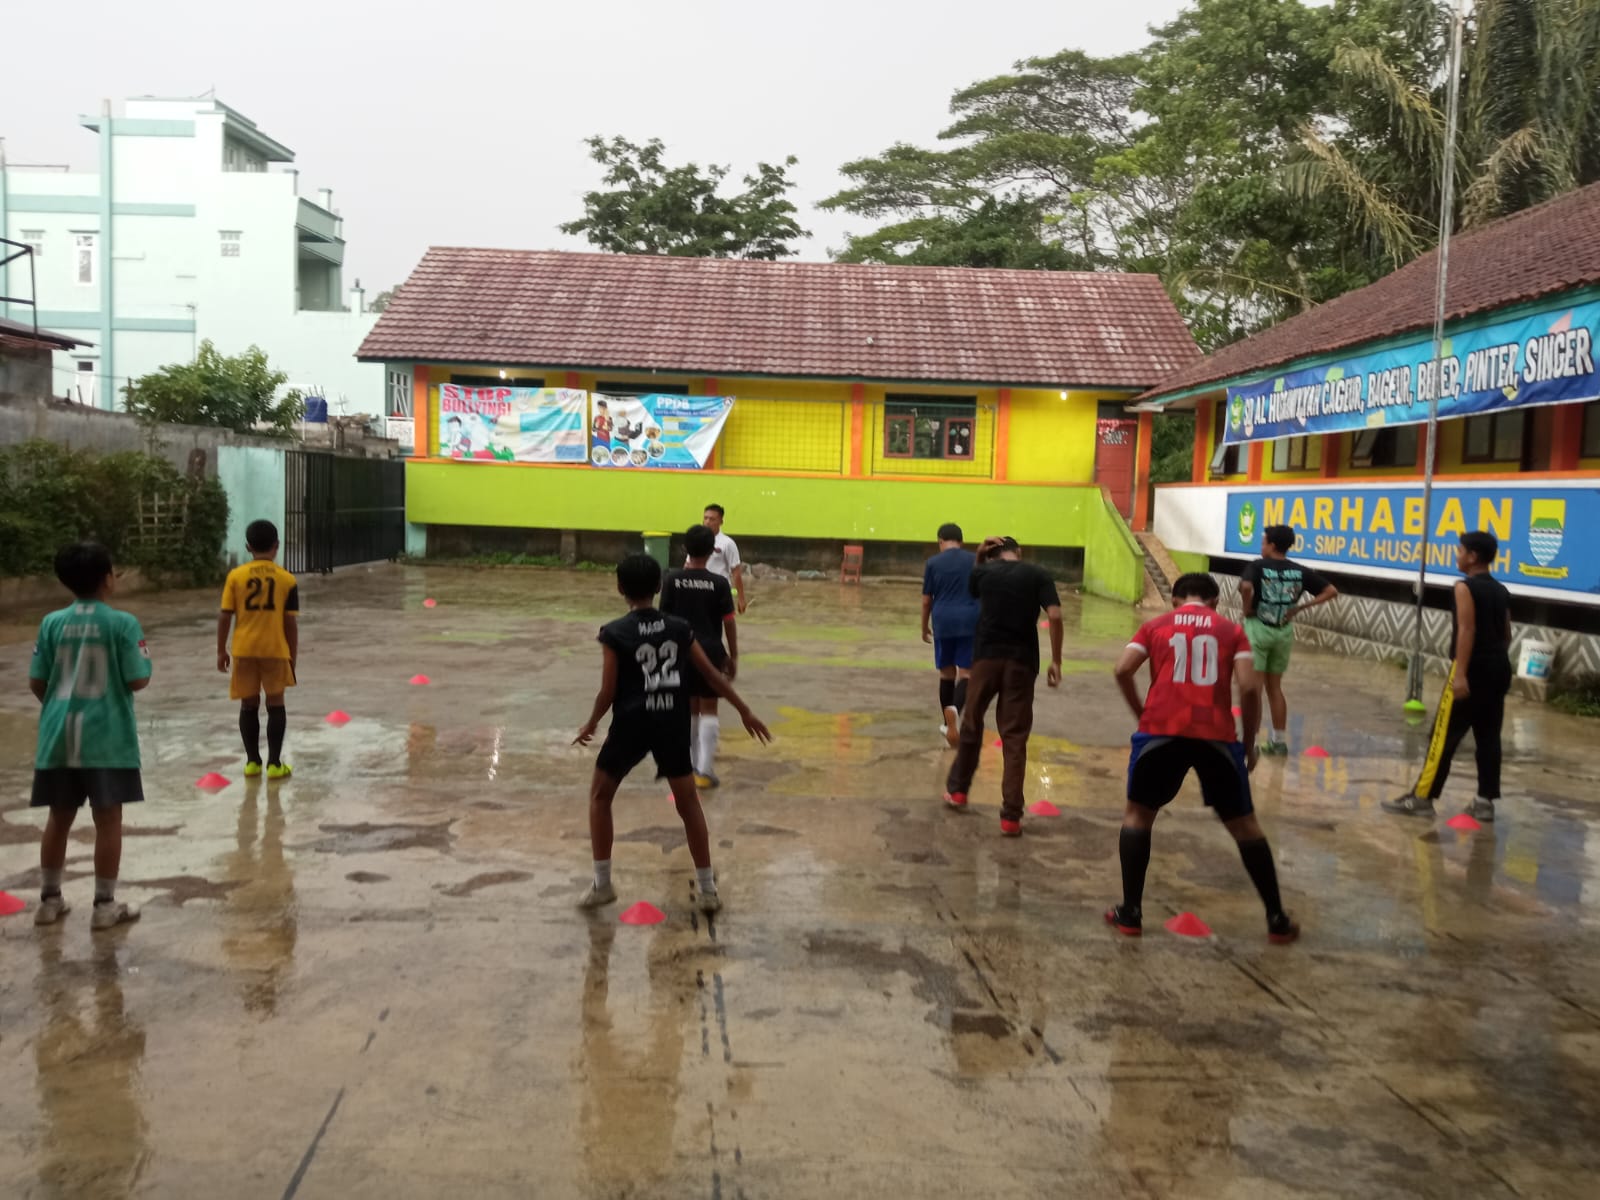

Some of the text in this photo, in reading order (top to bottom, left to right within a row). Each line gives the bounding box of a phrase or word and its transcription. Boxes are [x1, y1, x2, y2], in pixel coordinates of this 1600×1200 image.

[443, 386, 512, 400] STOP
[1322, 376, 1365, 414] CAGEUR,
[1367, 366, 1414, 407] BAGEUR,
[1463, 343, 1520, 394] PINTER,
[1523, 327, 1594, 384] SINGER
[442, 398, 512, 416] BULLYING!
[1263, 496, 1513, 541] MARHABAN
[1314, 535, 1347, 556] SMP
[1348, 537, 1370, 559] AL
[245, 576, 276, 611] 21
[54, 643, 109, 700] 10
[635, 639, 681, 692] 22
[1168, 632, 1219, 687] 10
